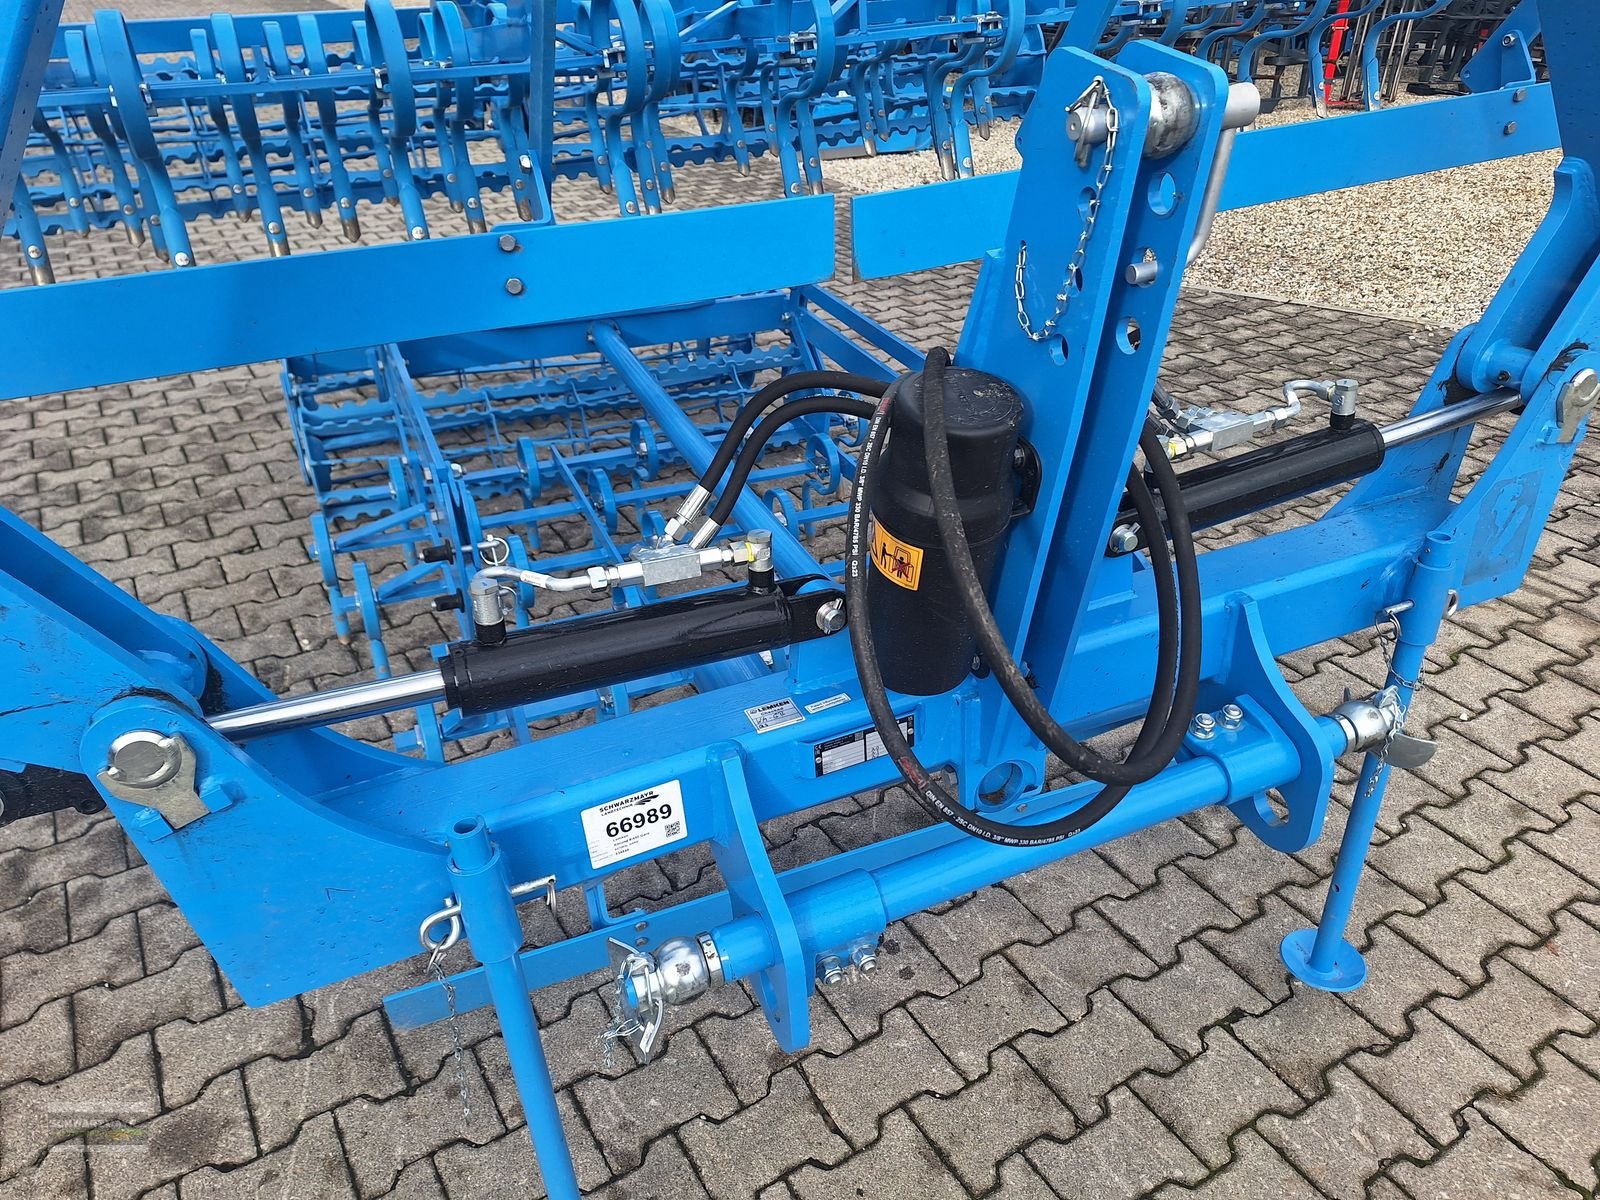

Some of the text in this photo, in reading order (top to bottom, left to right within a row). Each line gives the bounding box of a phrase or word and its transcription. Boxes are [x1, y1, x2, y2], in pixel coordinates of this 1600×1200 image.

[856, 487, 864, 501] MWP
[854, 502, 862, 513] 330
[851, 544, 859, 556] PSI
[757, 700, 790, 712] LEMKEN
[599, 791, 654, 813] SCHWARZMAYR
[601, 803, 633, 816] LANDTECHNIK
[925, 790, 936, 801] DIN
[934, 799, 944, 810] EN
[942, 807, 954, 817] 857
[955, 816, 968, 827] 2SC
[967, 823, 983, 835] DN10
[606, 804, 672, 838] 66989
